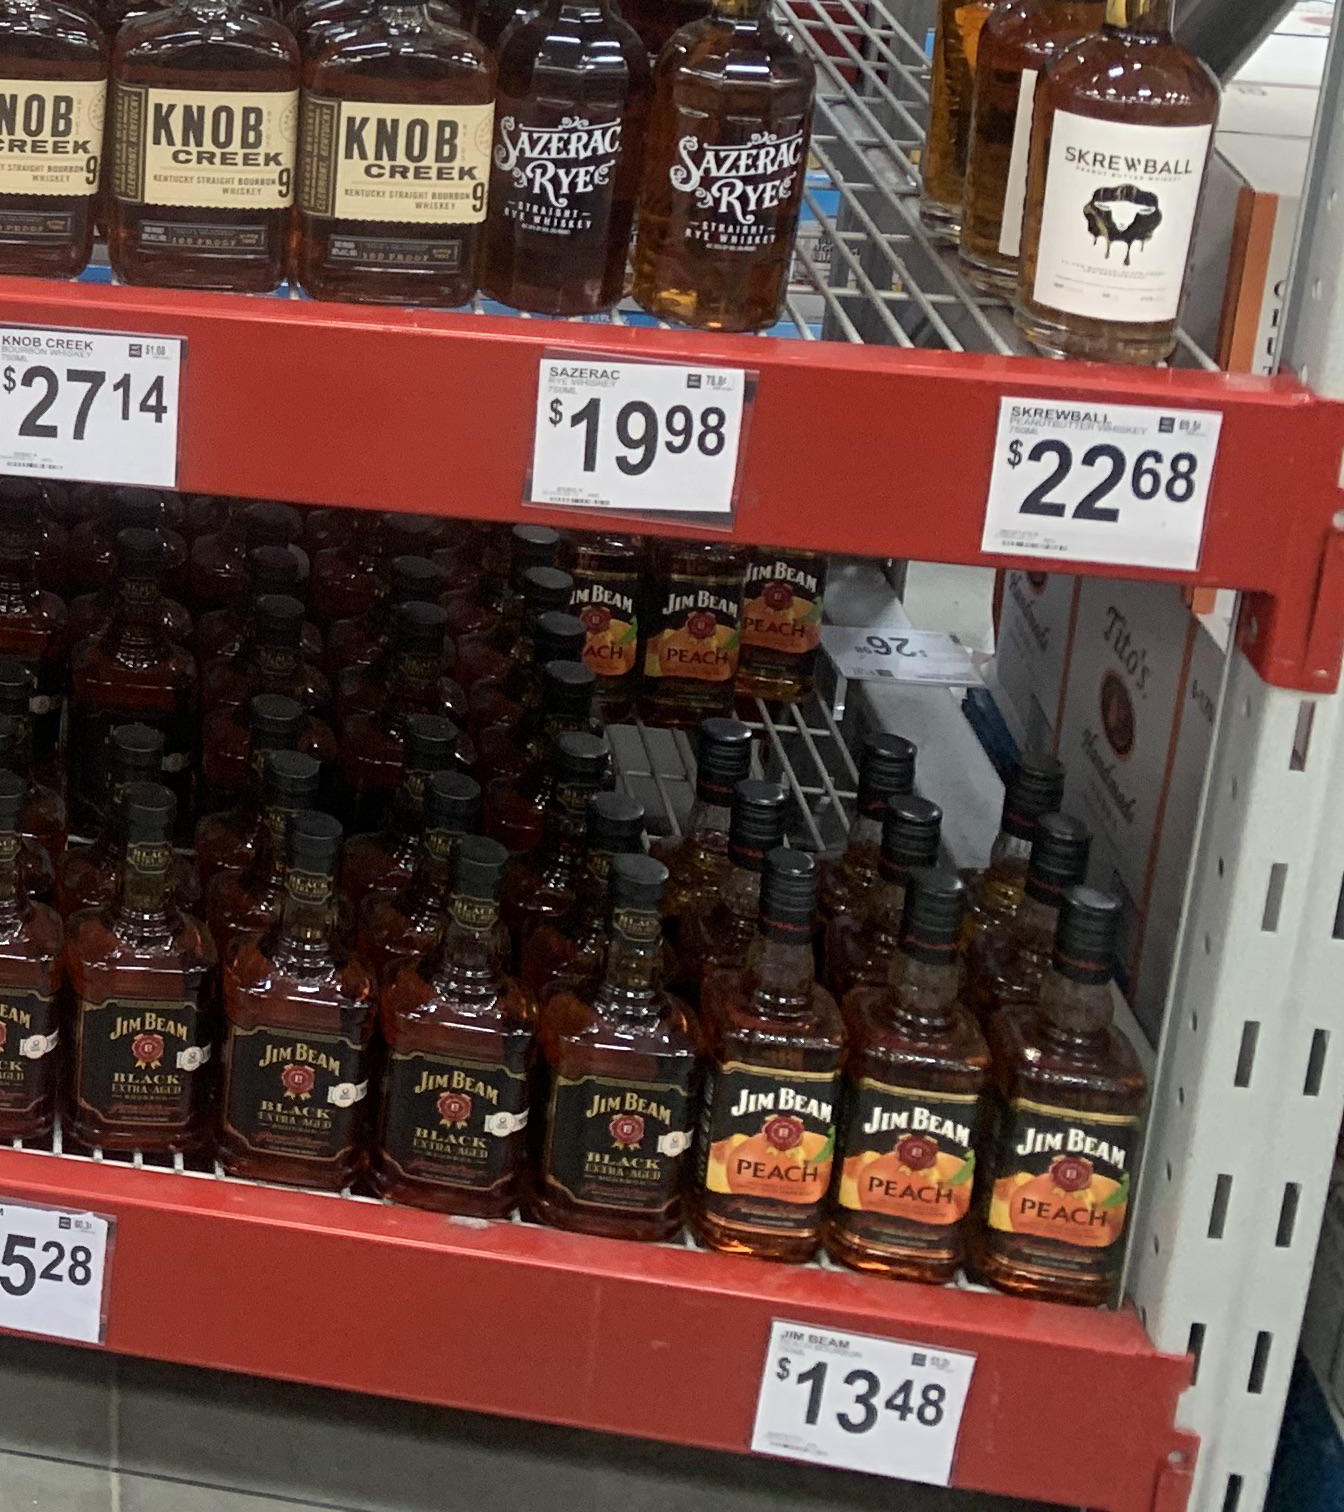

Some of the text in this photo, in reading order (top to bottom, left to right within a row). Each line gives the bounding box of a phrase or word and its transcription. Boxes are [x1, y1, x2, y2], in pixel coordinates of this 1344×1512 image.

[495, 116, 622, 171] SAZERAC
[1065, 146, 1192, 175] SKREWBALL
[2, 336, 93, 350] KNOB CREEK
[550, 367, 621, 380] SAZERAC
[1011, 407, 1108, 425] SKREWBALL
[114, 1073, 179, 1084] BLACK
[736, 1159, 818, 1182] PEACH
[868, 1176, 952, 1204] PEACH
[781, 1330, 850, 1350] JIM BEAM
